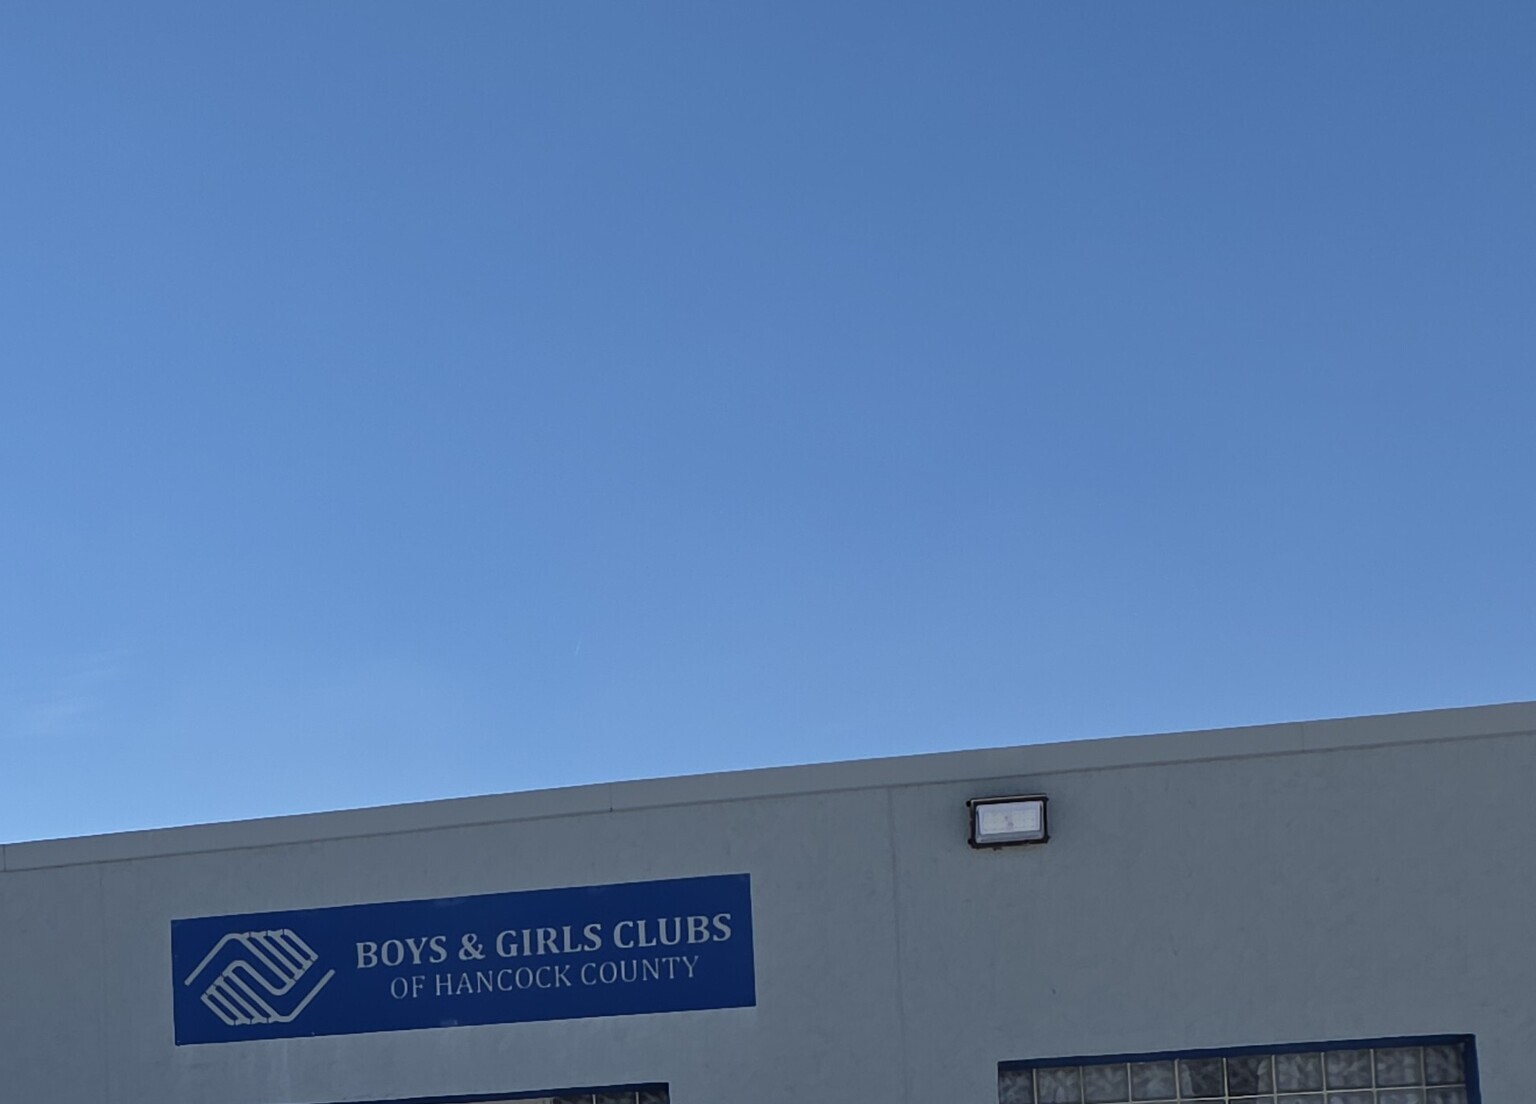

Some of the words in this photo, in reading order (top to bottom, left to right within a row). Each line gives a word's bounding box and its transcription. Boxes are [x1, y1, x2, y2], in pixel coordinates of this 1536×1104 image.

[356, 934, 448, 969] BOYS
[458, 931, 486, 960] &
[496, 922, 602, 958] GIRLS
[613, 913, 733, 950] CLUBS
[390, 975, 425, 1000] OF
[434, 964, 573, 997] HANCOCK
[581, 955, 701, 986] COUNTY
